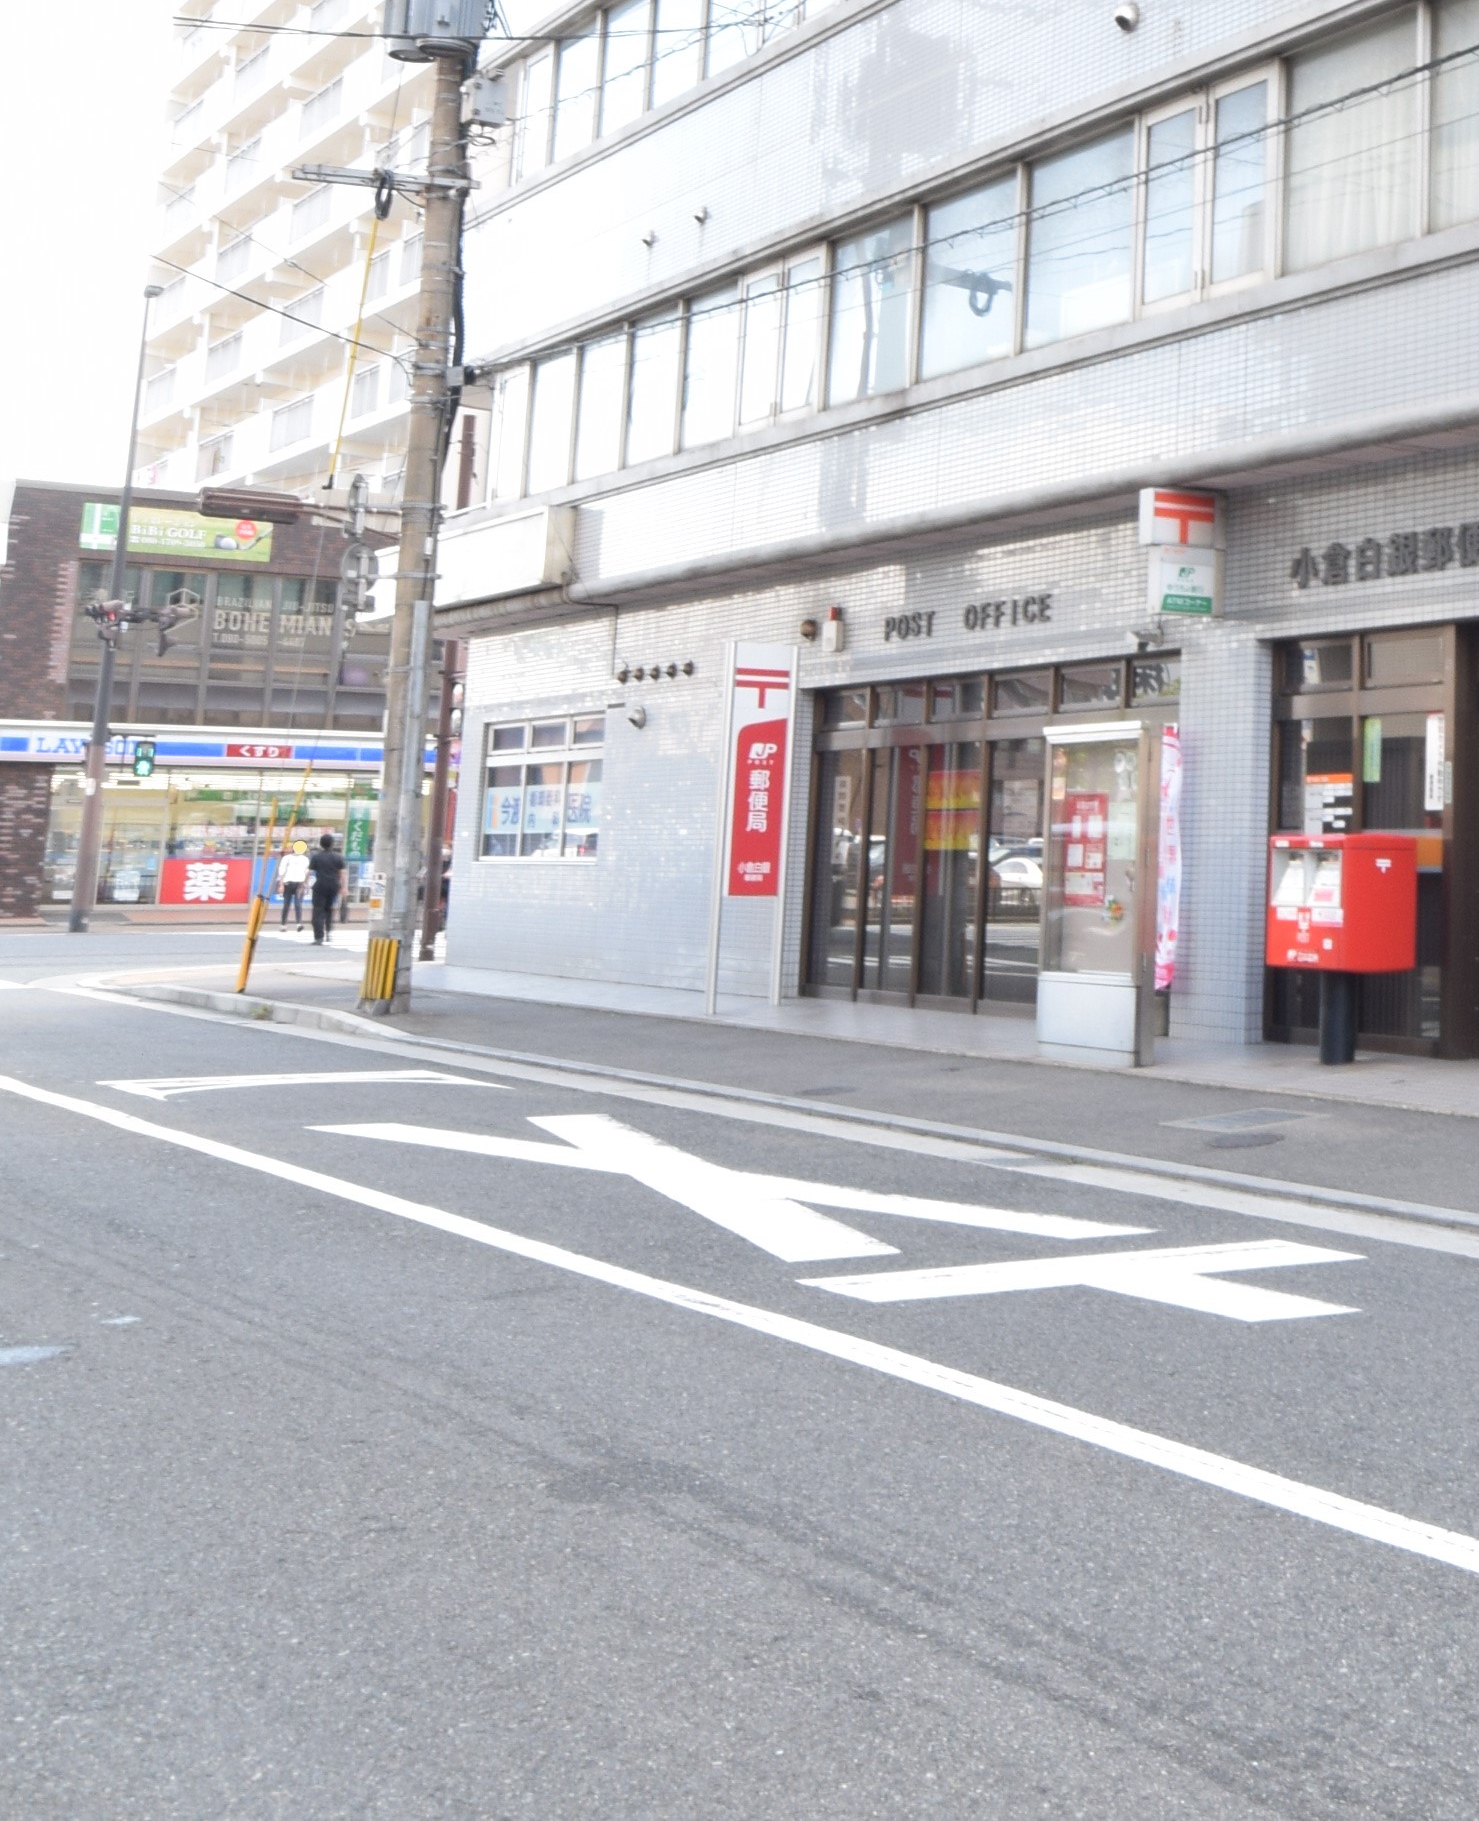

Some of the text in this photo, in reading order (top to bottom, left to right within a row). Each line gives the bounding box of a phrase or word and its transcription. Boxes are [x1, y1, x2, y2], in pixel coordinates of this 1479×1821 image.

[166, 528, 207, 540] GOLF
[884, 593, 1052, 642] POST OFFICE
[238, 745, 279, 758] くすり
[566, 792, 592, 824] 医院
[746, 769, 770, 834] 郵便局
[183, 861, 229, 902] 薬
